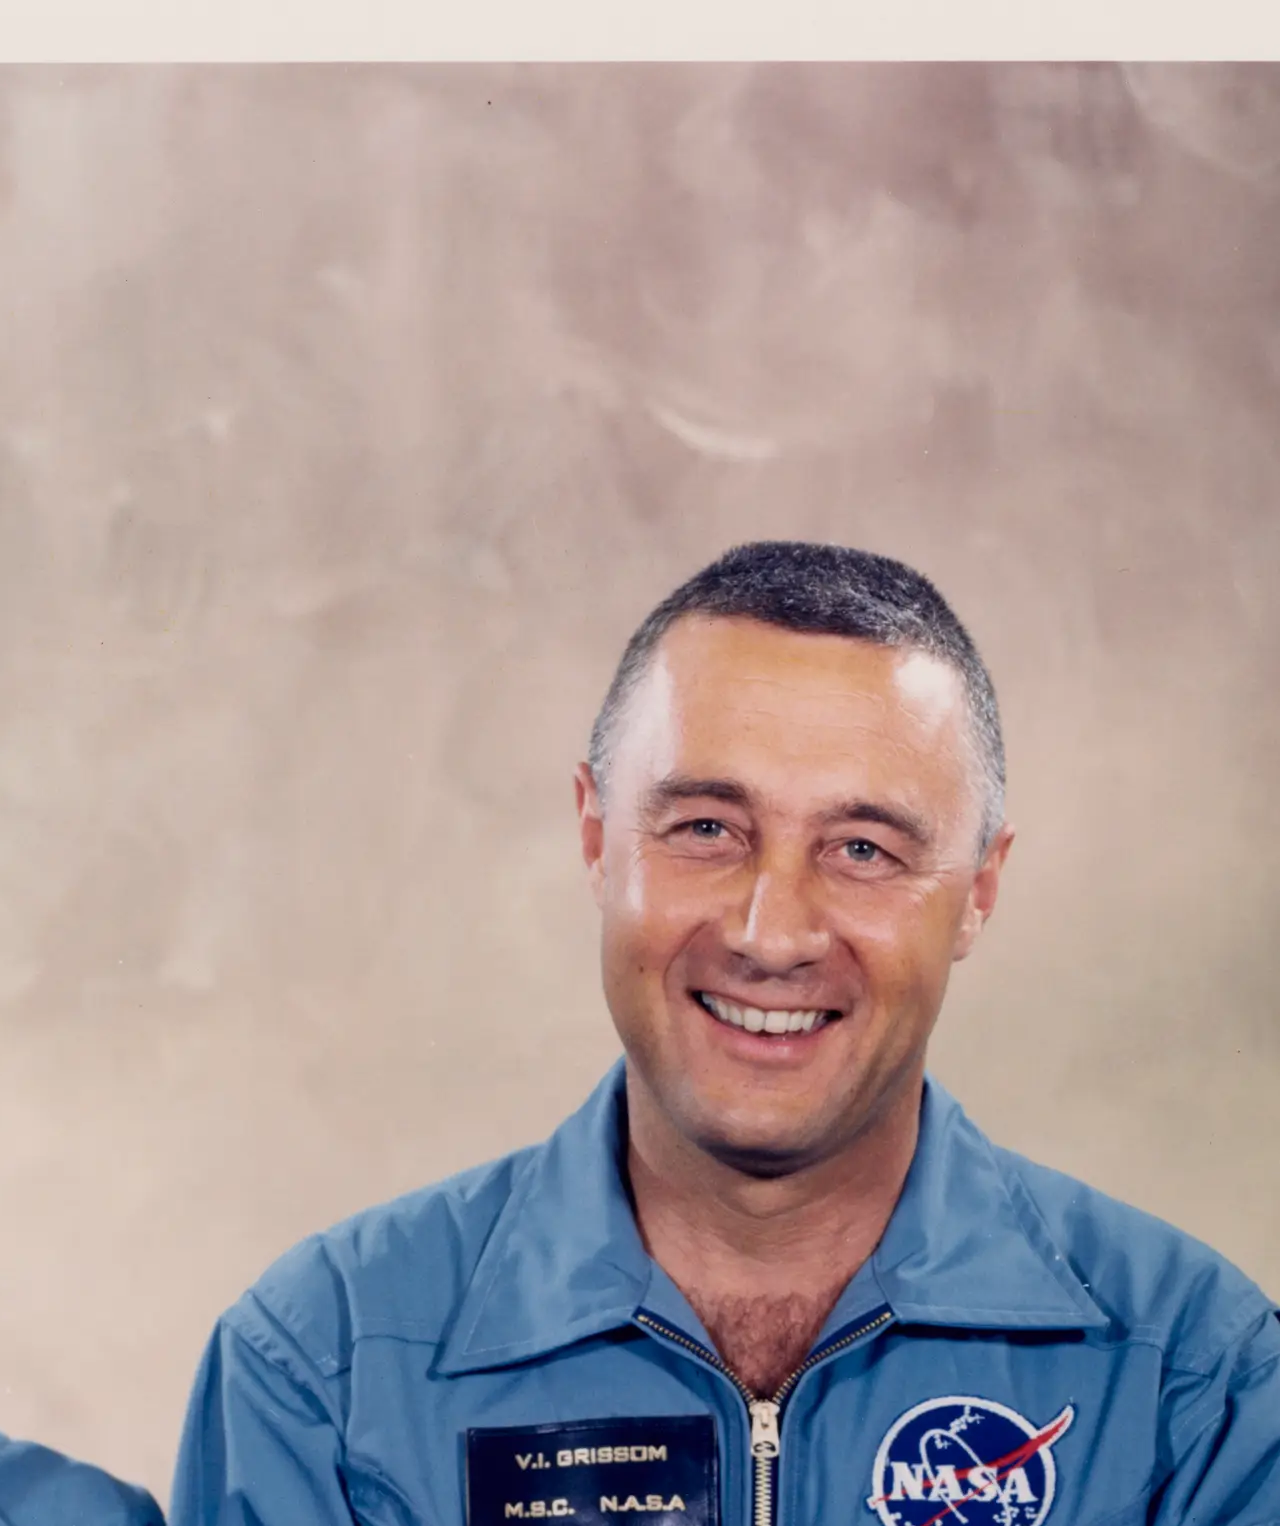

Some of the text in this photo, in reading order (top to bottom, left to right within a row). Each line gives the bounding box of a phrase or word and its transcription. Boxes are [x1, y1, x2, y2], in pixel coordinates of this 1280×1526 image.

[515, 1445, 668, 1470] V.I. GRISSOM
[892, 1461, 1038, 1502] NASA
[504, 1494, 687, 1518] M.S.C. N.A.S.A
